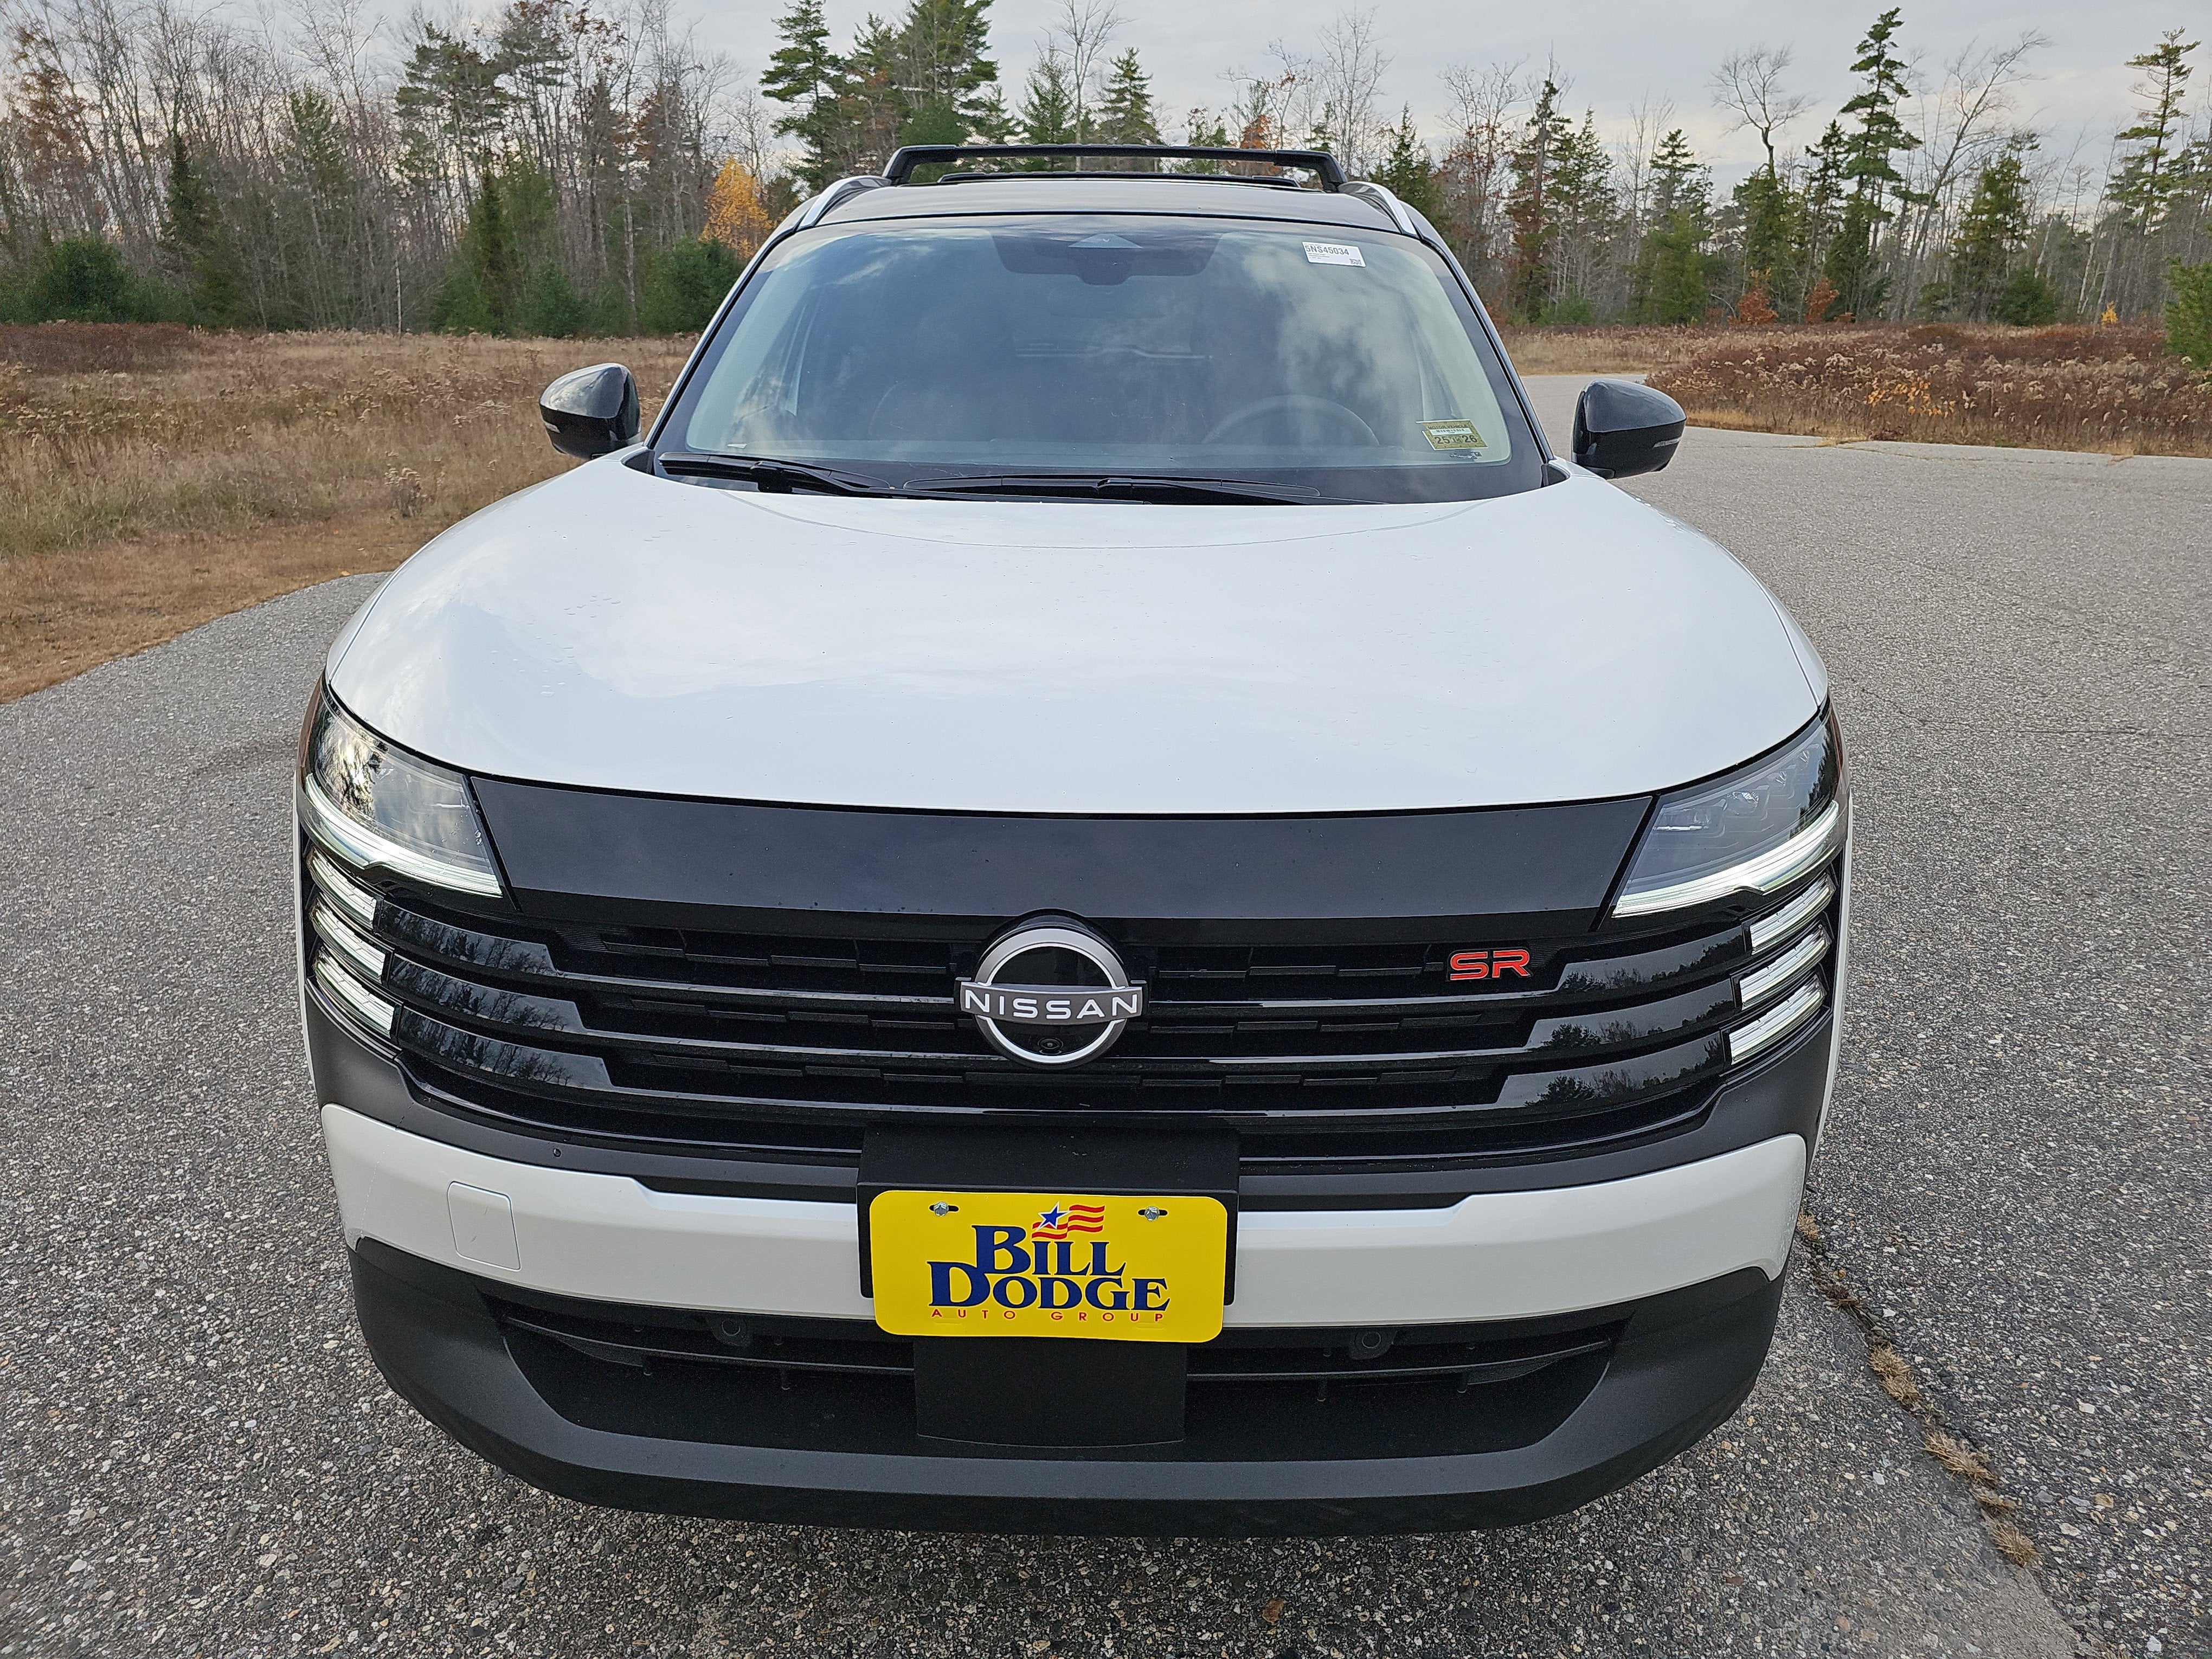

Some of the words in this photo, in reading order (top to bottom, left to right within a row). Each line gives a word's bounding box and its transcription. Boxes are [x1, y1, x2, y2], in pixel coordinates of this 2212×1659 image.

[1305, 245, 1349, 255] 5NS45034
[1434, 436, 1450, 444] 25
[1462, 435, 1477, 443] 26
[1450, 949, 1531, 980] SR
[964, 989, 1137, 1019] NISSAN
[972, 1225, 1126, 1276] BILL
[927, 1261, 1171, 1311] DODGE
[931, 1308, 1016, 1320] AUTO
[1050, 1311, 1164, 1322] GROUP
